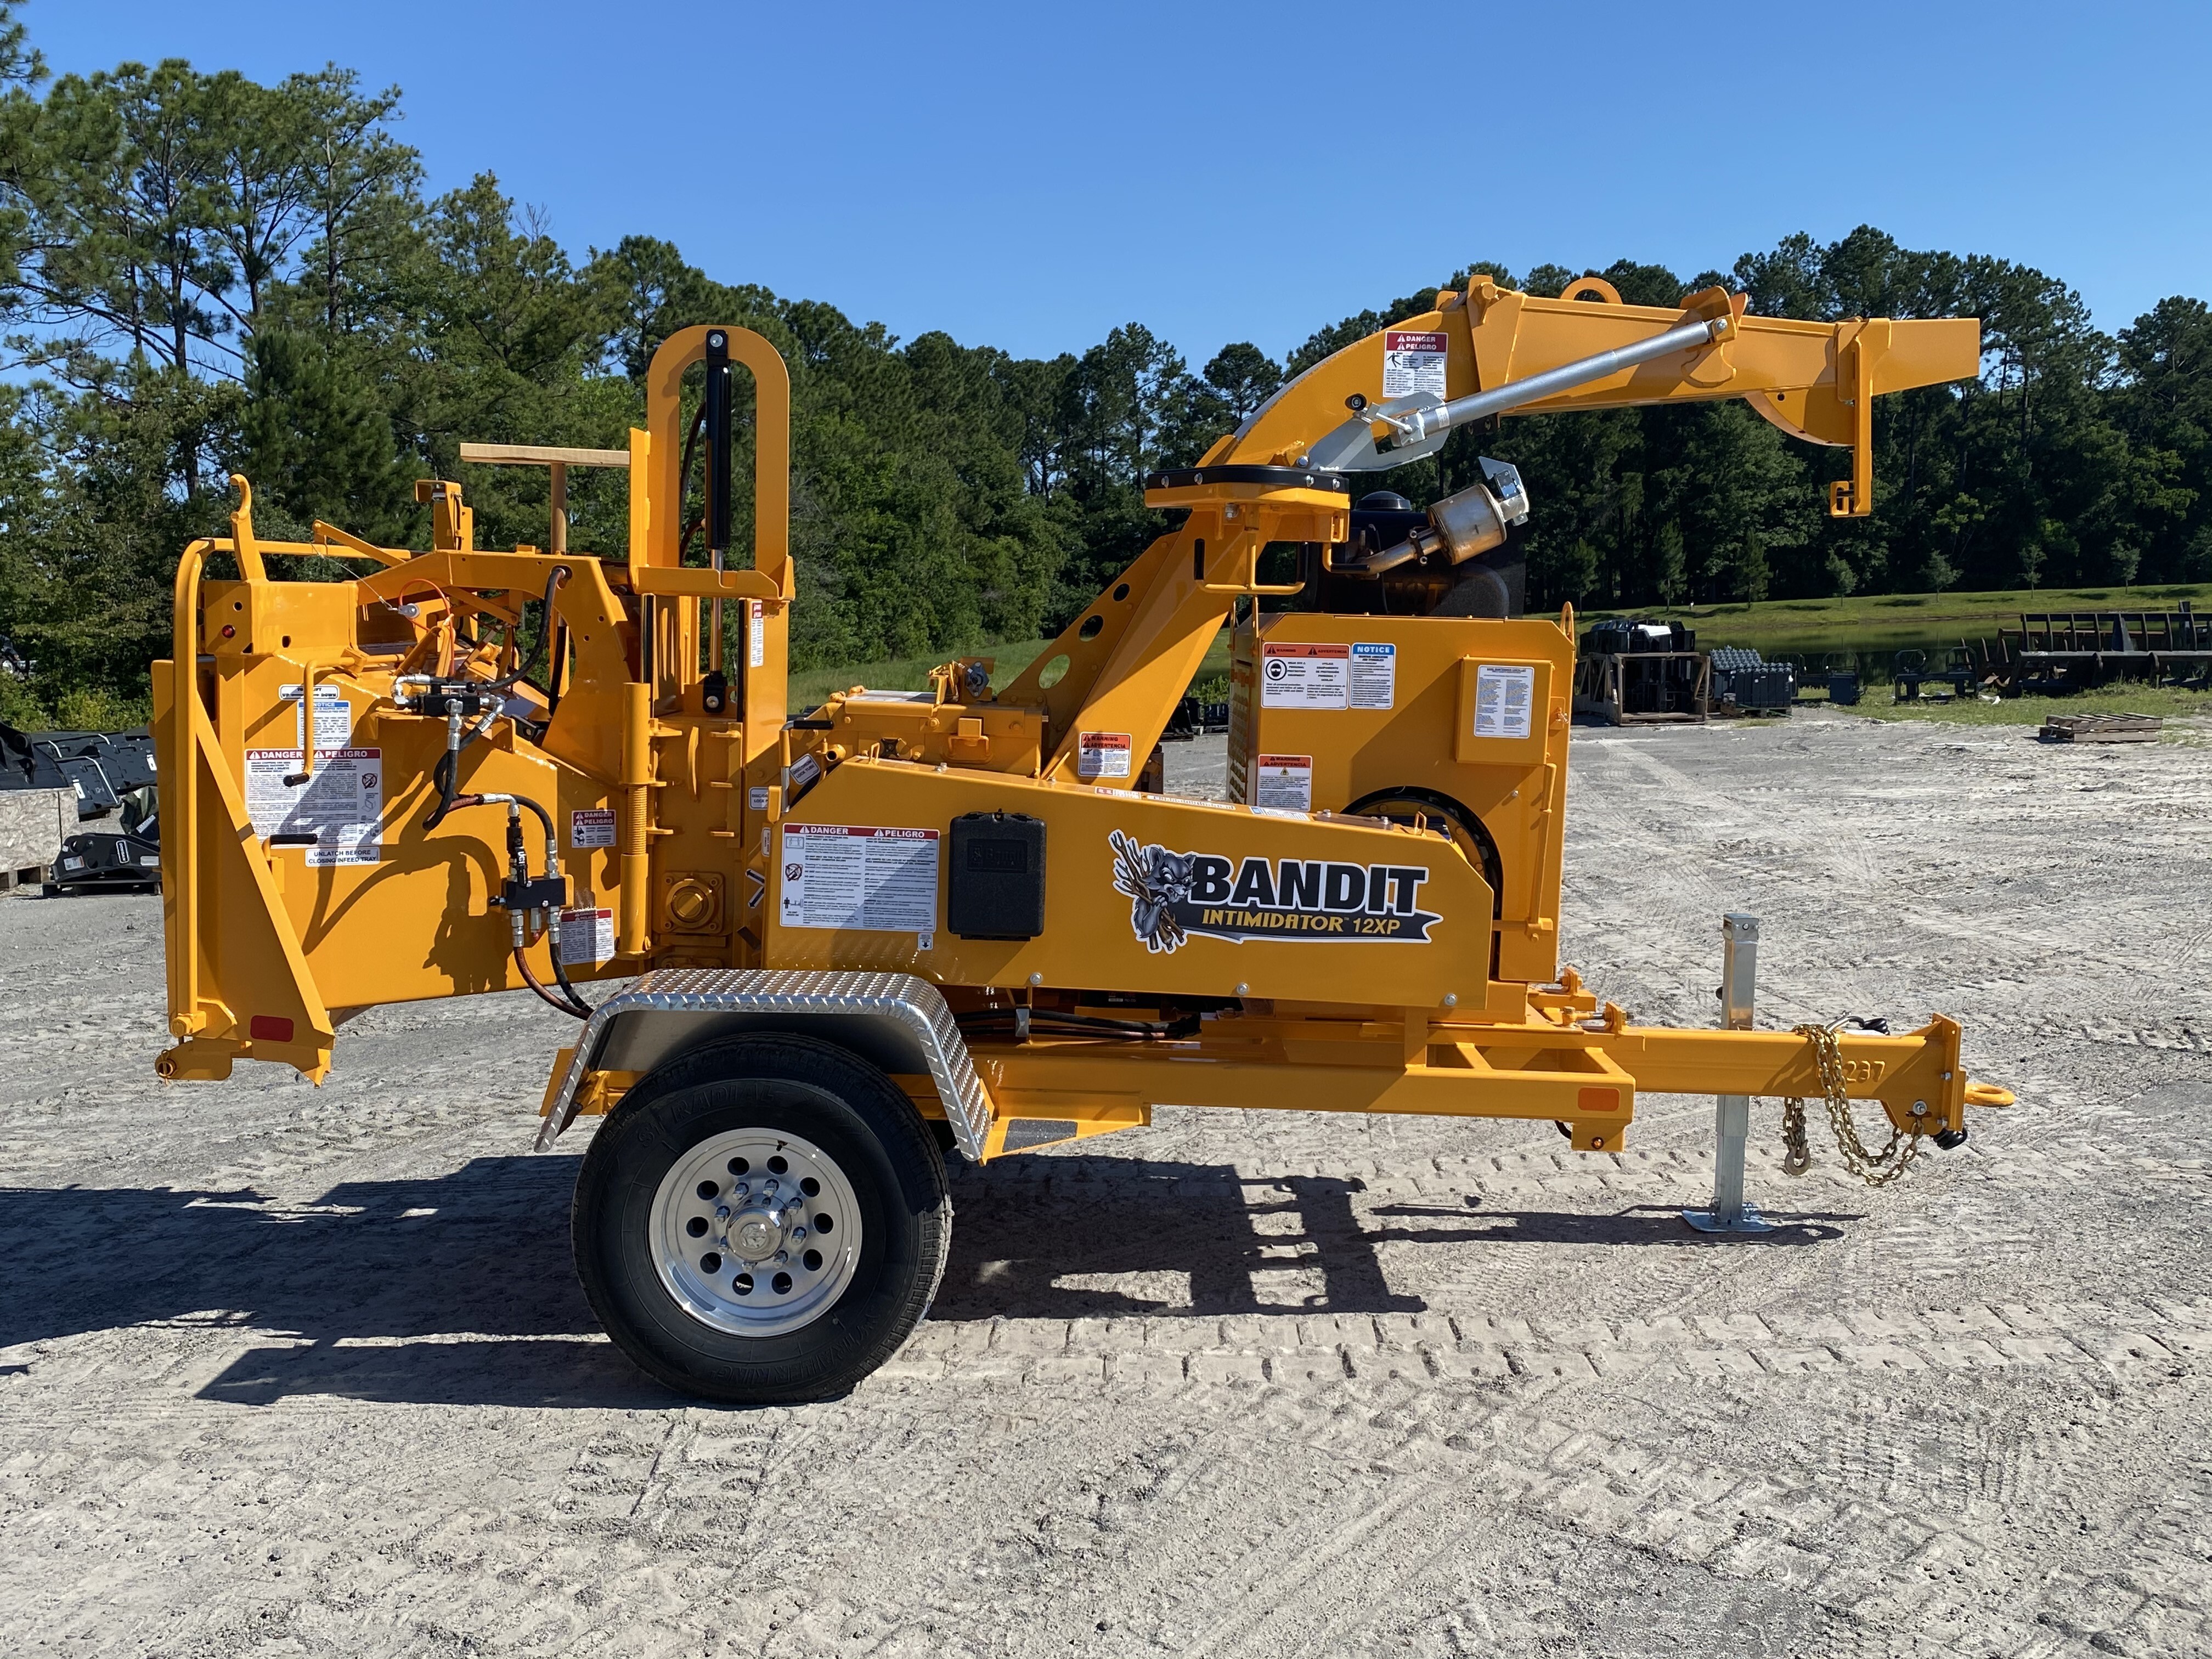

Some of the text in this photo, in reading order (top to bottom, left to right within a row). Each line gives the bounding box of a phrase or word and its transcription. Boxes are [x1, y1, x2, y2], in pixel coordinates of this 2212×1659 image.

[810, 826, 849, 834] DANGER
[1189, 856, 1427, 915] BANDIT
[1352, 919, 1401, 935] 12XP
[671, 1082, 775, 1124] RADIAL
